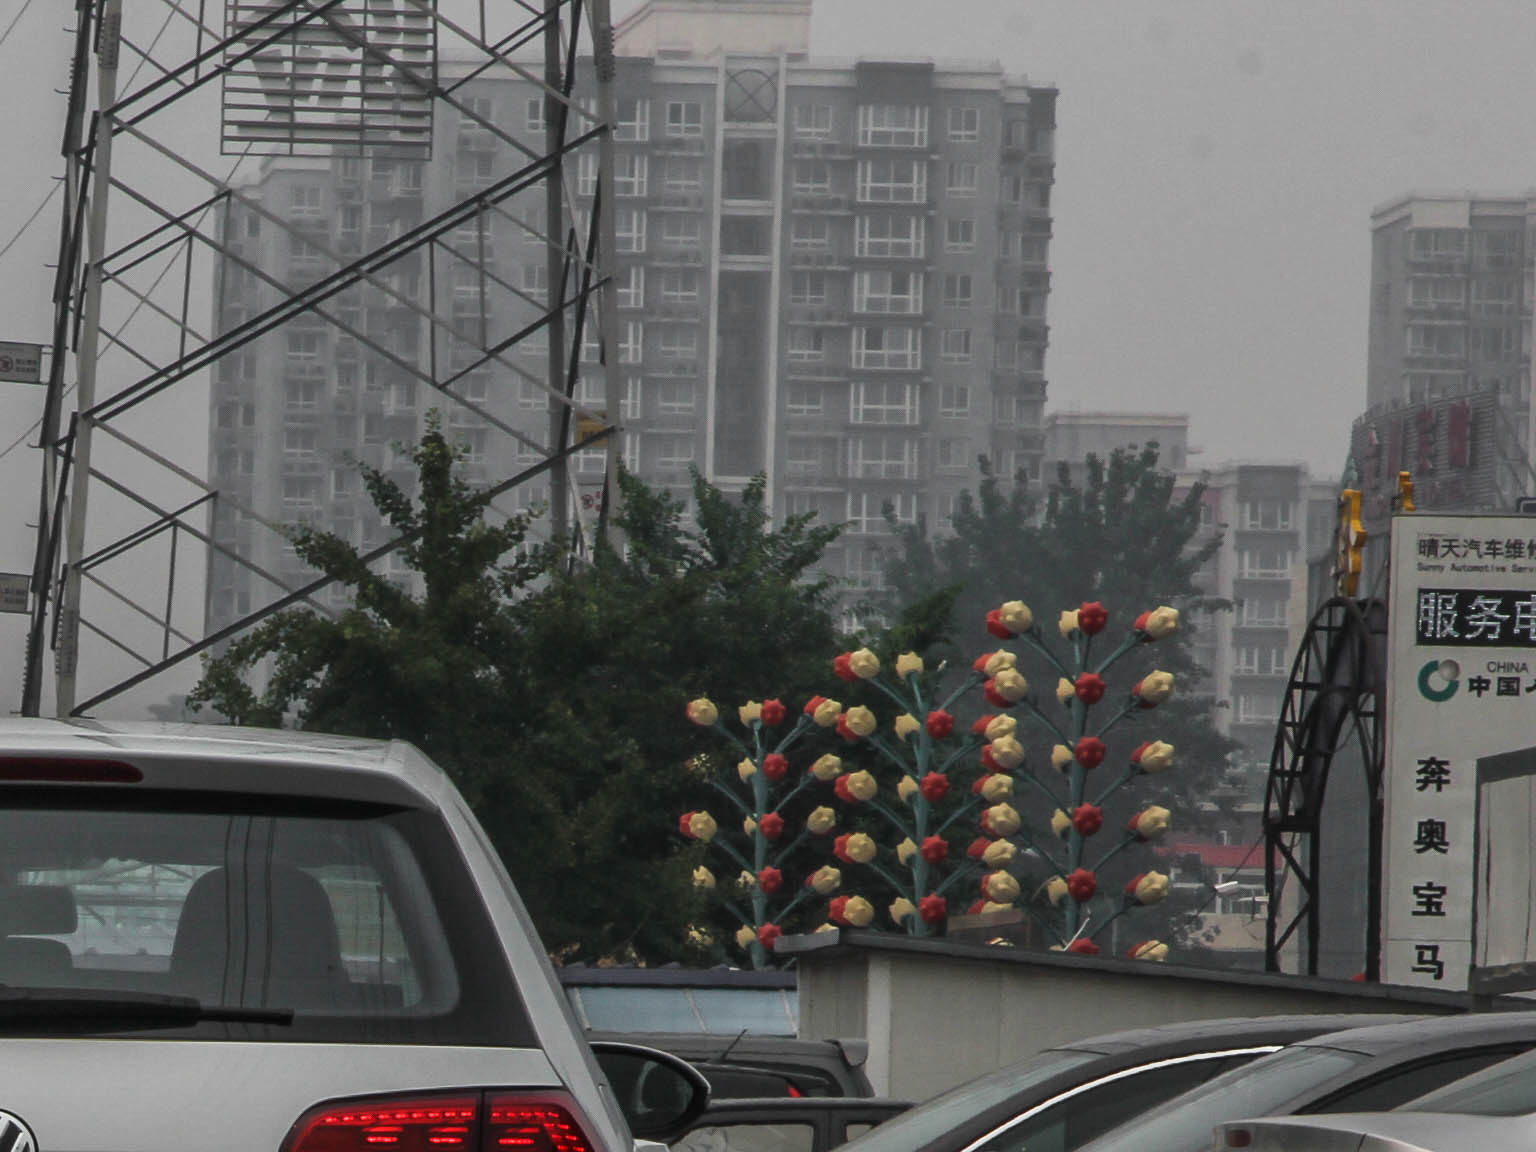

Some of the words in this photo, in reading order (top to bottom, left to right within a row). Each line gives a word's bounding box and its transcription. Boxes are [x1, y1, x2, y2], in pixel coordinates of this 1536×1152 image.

[1487, 661, 1528, 673] CHINA
[1411, 757, 1451, 980] 奔奥宝马
